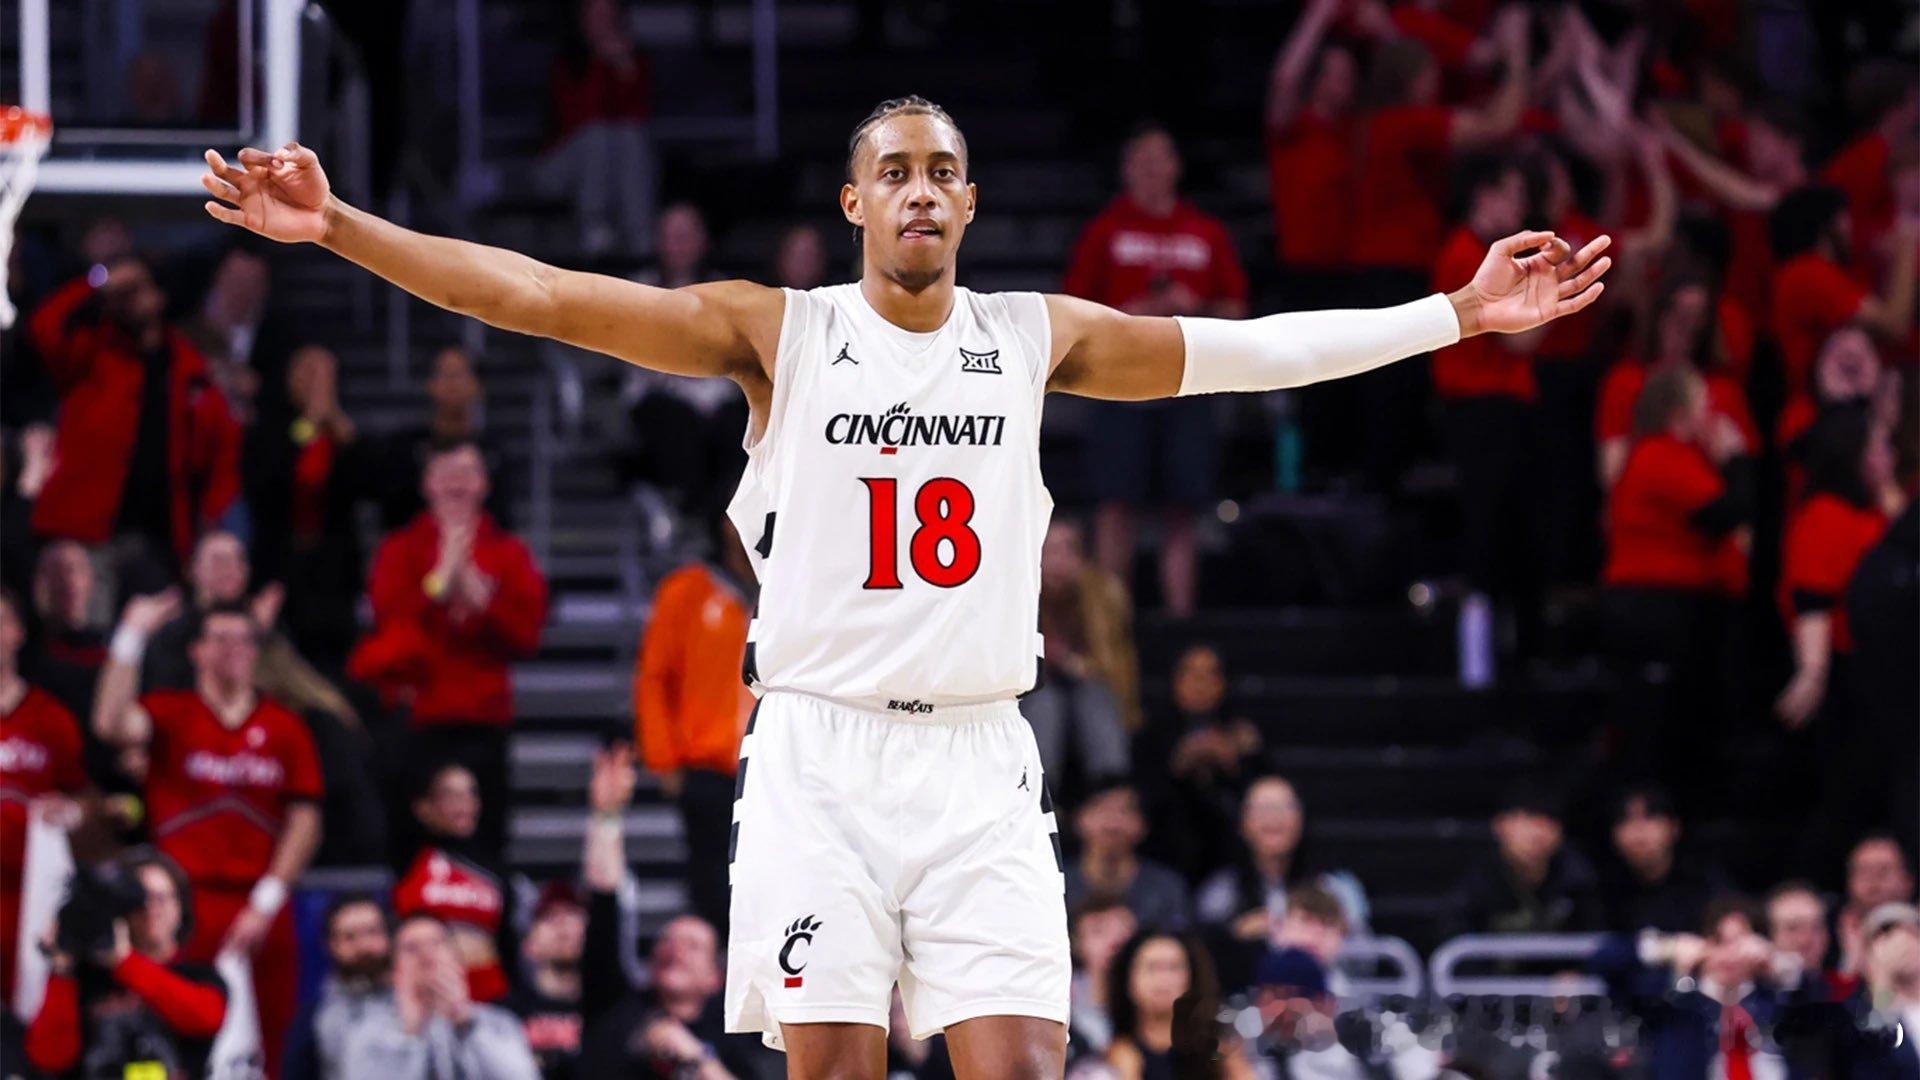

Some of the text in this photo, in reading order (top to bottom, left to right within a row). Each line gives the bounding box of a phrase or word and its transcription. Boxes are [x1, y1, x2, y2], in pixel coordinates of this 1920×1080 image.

[959, 347, 1002, 375] XII
[825, 408, 1006, 448] CINCINNATI
[857, 477, 981, 589] 18
[887, 699, 934, 714] BEARCATS
[779, 914, 822, 976] C
